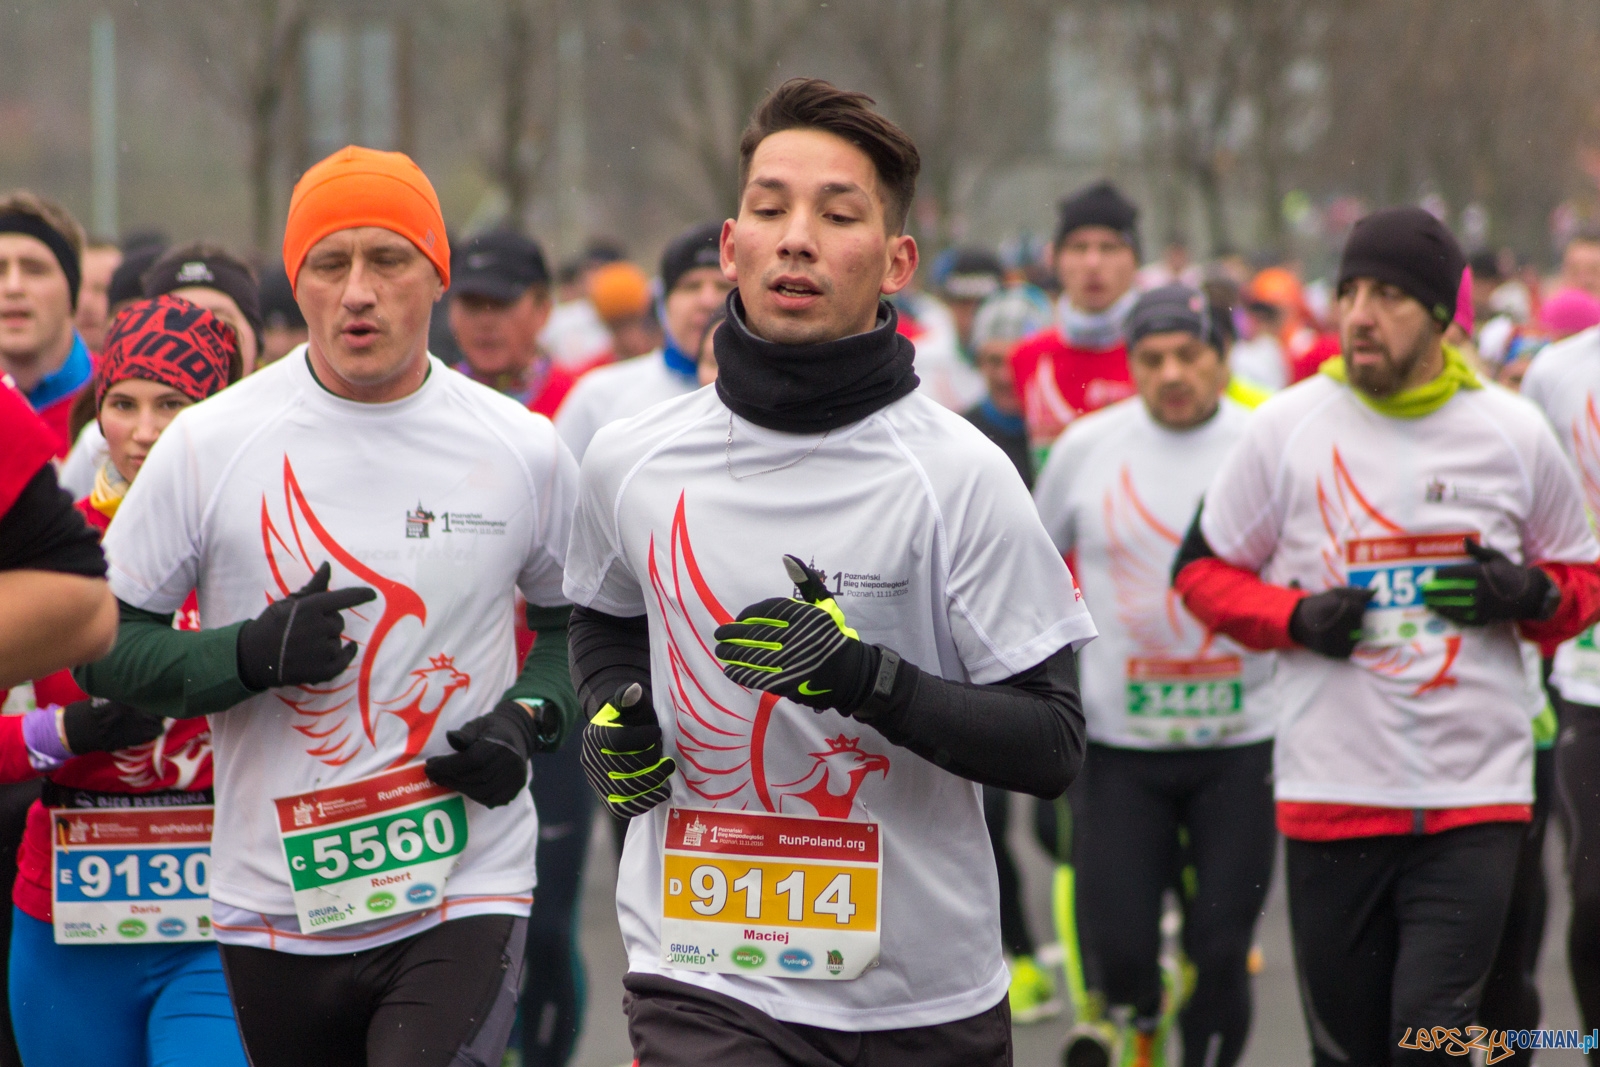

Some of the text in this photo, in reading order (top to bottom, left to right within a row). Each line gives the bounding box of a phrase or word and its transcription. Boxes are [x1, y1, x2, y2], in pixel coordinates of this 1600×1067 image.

[441, 511, 452, 533] 1
[832, 571, 844, 596] 1
[843, 579, 909, 589] Bieg Niepodległości
[844, 573, 881, 581] Poznański
[710, 825, 719, 843] 1
[291, 808, 455, 880] C 5560
[779, 834, 866, 852] RunPoland.org
[60, 852, 212, 898] E 9130
[370, 871, 412, 888] Robert
[669, 864, 857, 925] D 9114
[130, 904, 162, 915] Daria
[308, 905, 339, 918] GRUPA
[310, 912, 347, 927] LUXMED
[743, 929, 790, 945] Maciej
[670, 943, 700, 955] GRUPA
[670, 952, 706, 965] UXMED
